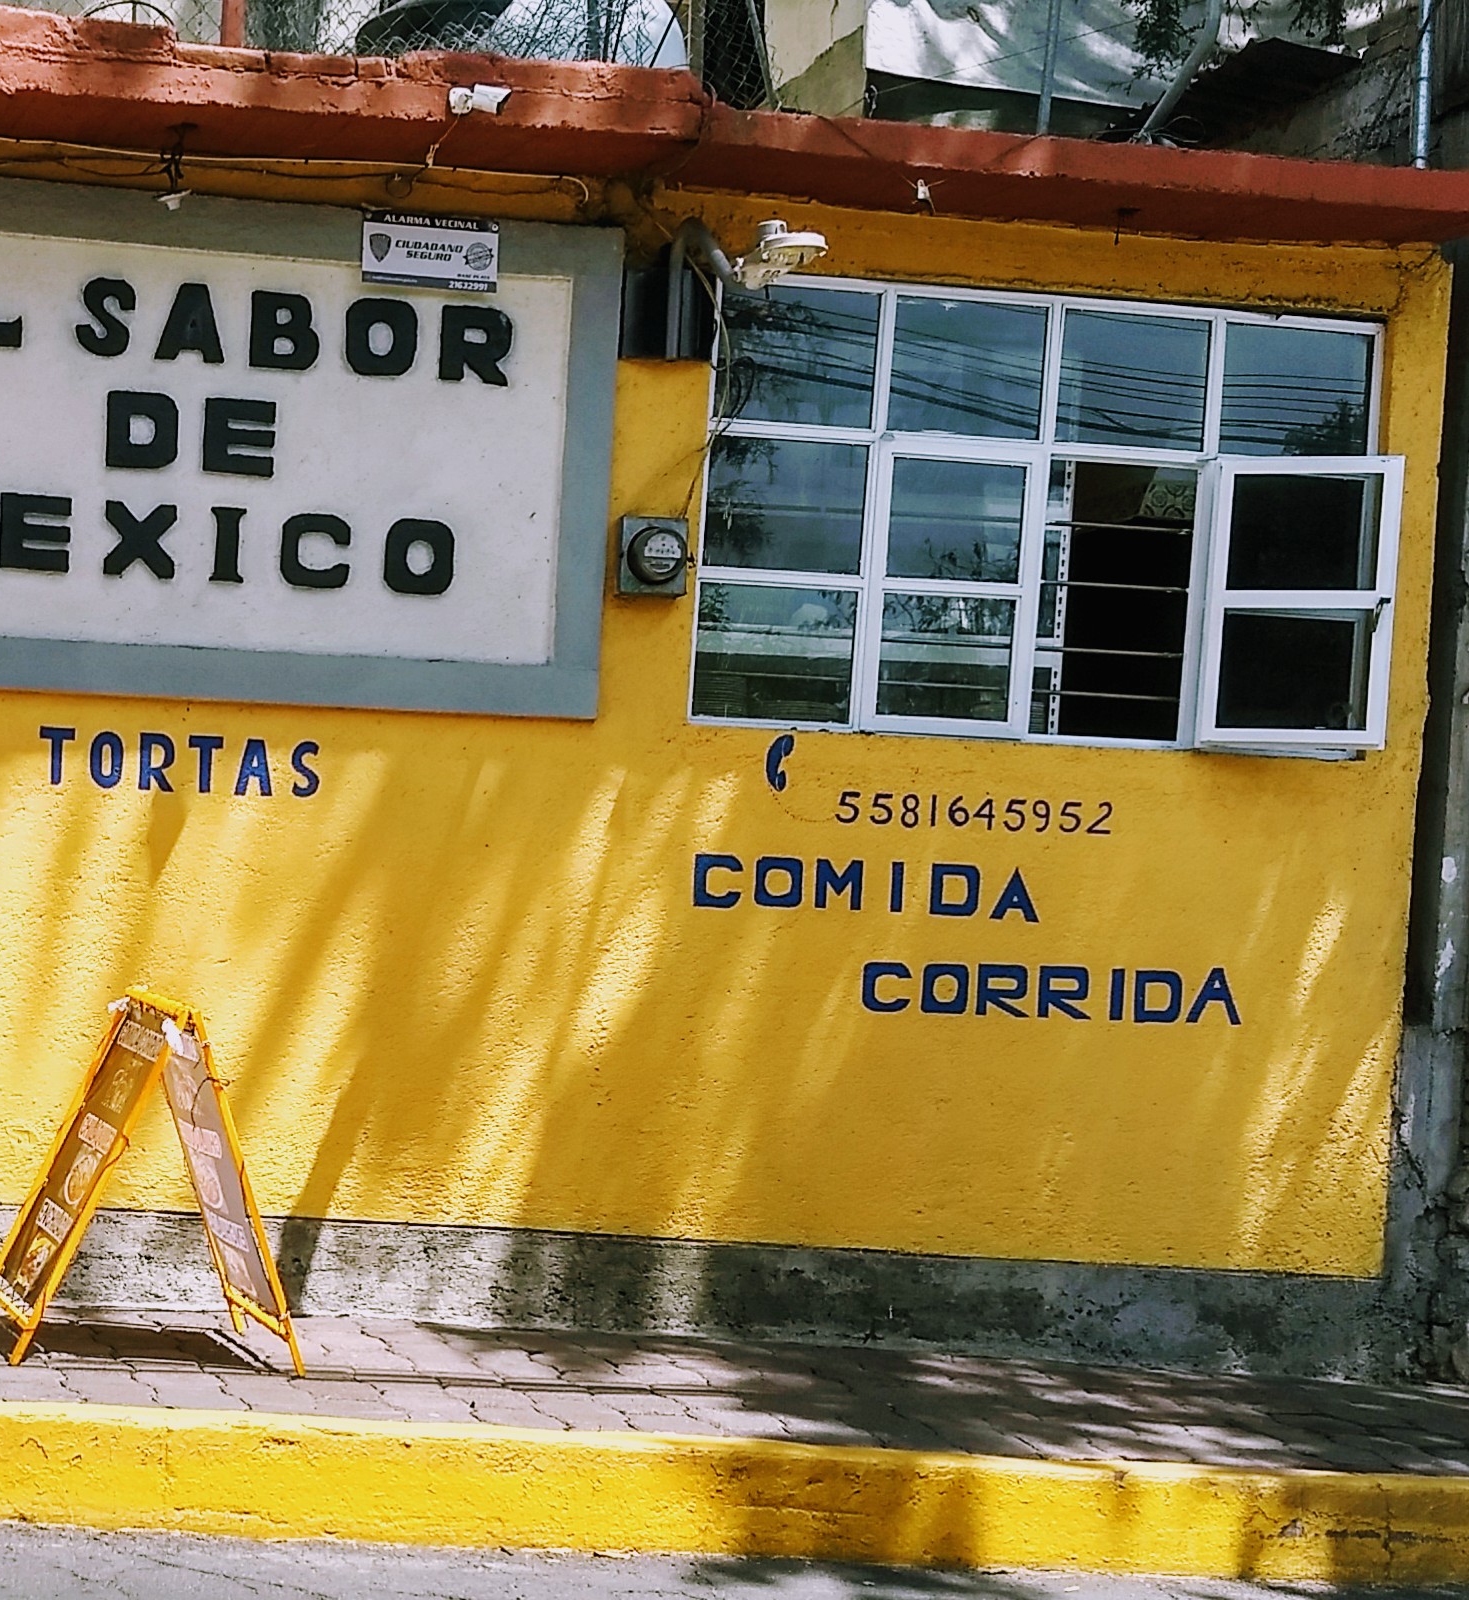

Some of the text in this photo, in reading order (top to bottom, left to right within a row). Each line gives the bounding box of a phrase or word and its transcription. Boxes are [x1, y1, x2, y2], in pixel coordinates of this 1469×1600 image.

[384, 214, 479, 230] ALARMA VECINAL
[395, 240, 463, 253] CIUDADANO
[406, 250, 452, 262] SEGURO
[448, 281, 488, 291] 21632991
[75, 276, 515, 387] SABOR
[106, 390, 277, 478] DE
[39, 726, 320, 798] TORTAS
[834, 790, 1114, 835] 5581645952
[693, 853, 1040, 923] COMIDA
[862, 961, 1242, 1026] CORRIDA
